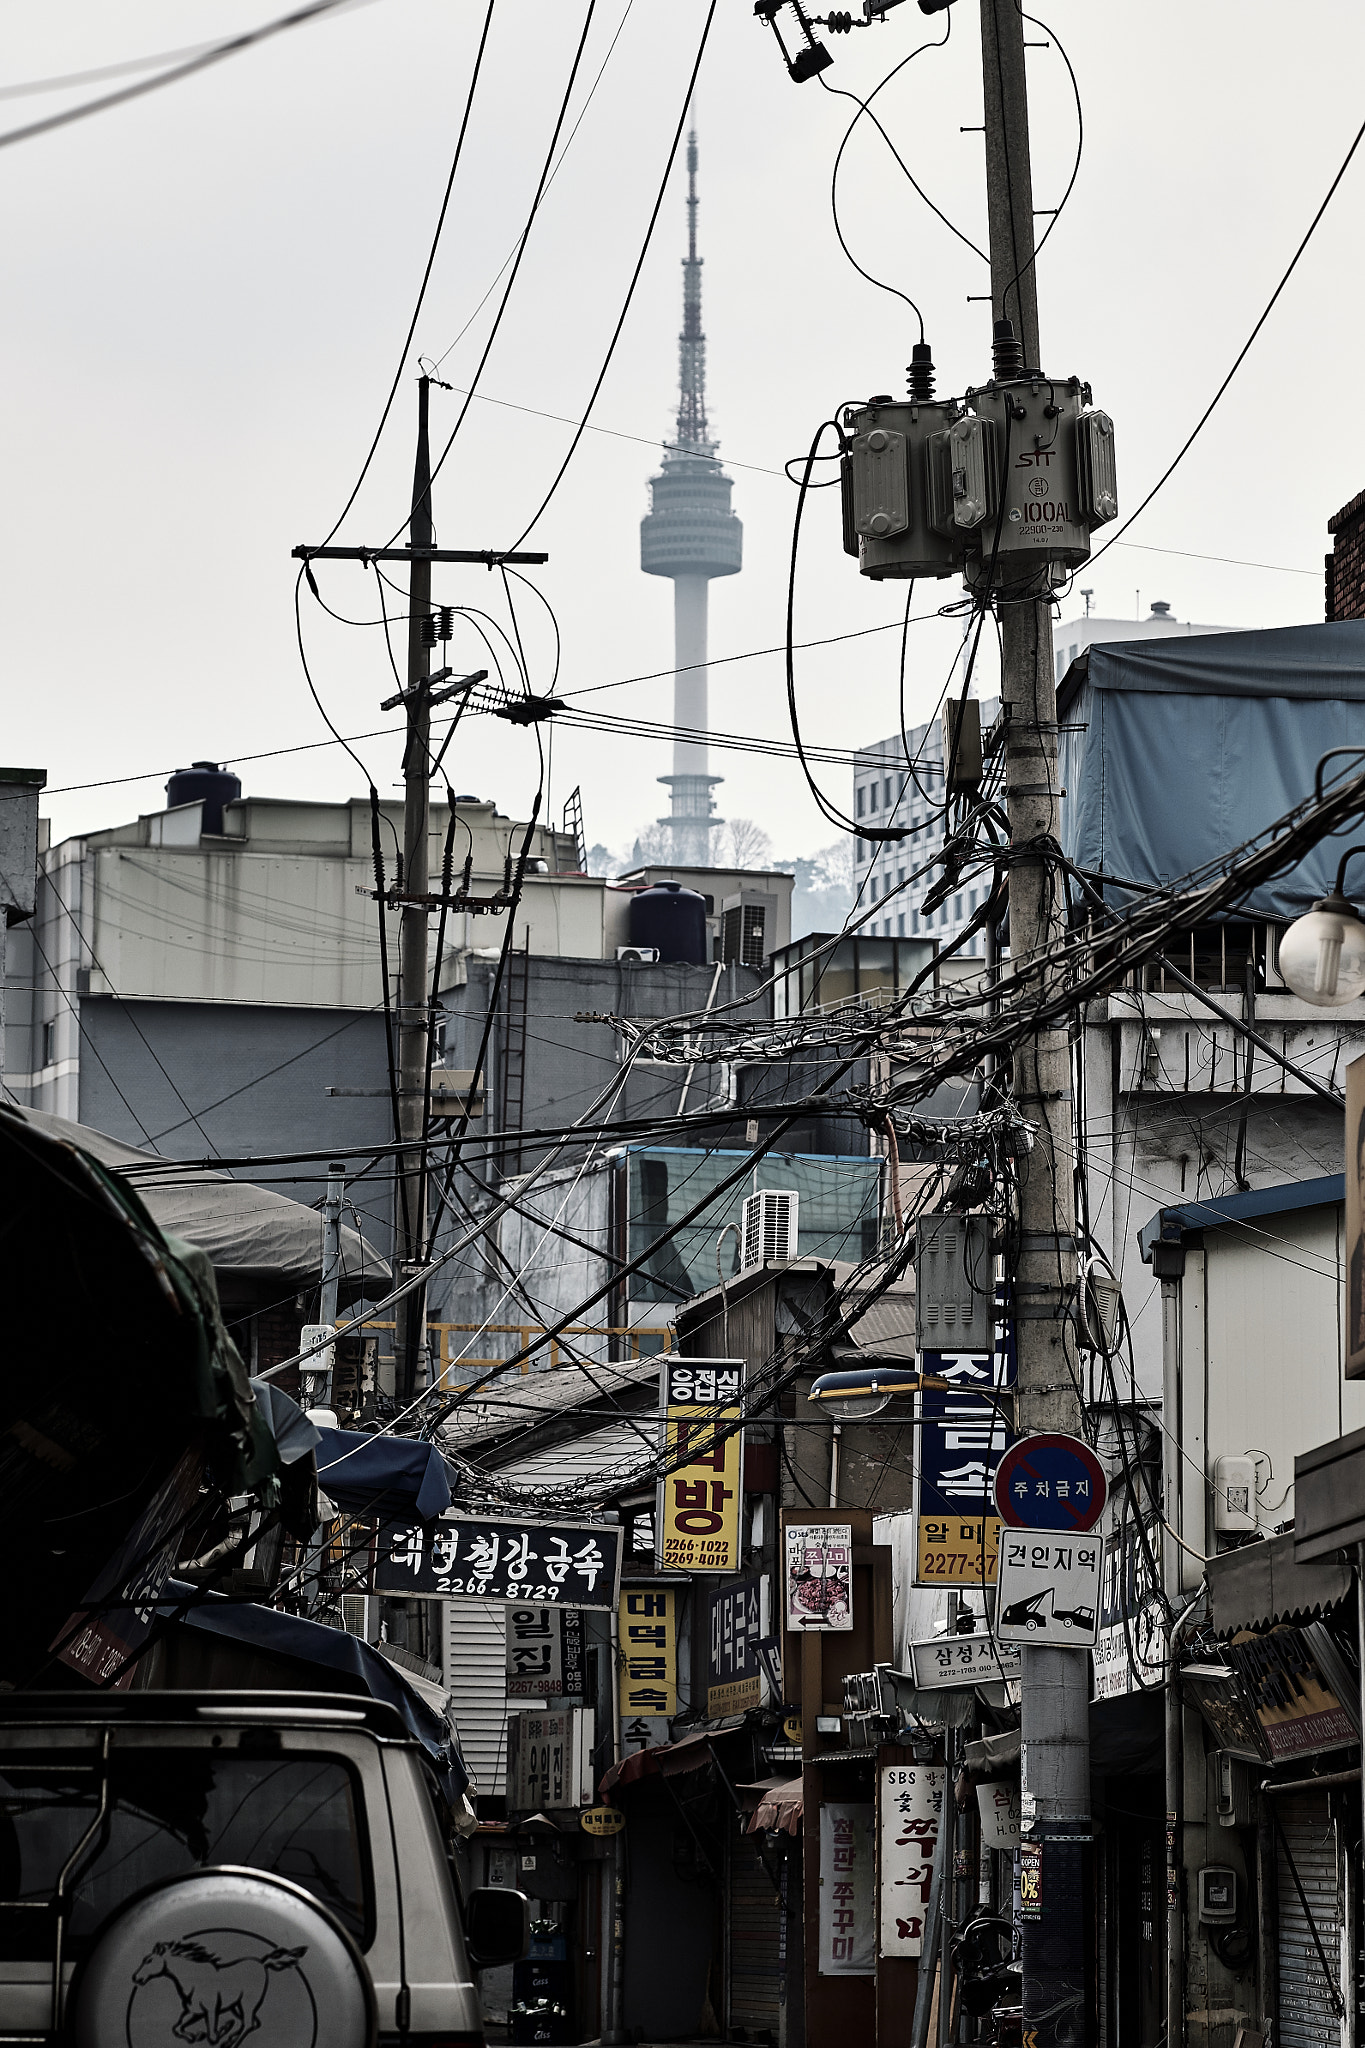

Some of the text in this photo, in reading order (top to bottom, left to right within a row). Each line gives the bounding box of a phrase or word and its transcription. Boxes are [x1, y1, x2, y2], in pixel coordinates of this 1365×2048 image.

[1013, 1479, 1090, 1499] 주차금지
[924, 1523, 1000, 1546] 알미
[1008, 1544, 1096, 1573] 견인지역
[435, 1577, 560, 1600] 2266-8729
[508, 1679, 562, 1694] 2267-9848
[888, 1771, 916, 1785] SBS
[832, 1818, 856, 1961] 철판 쭈꾸미
